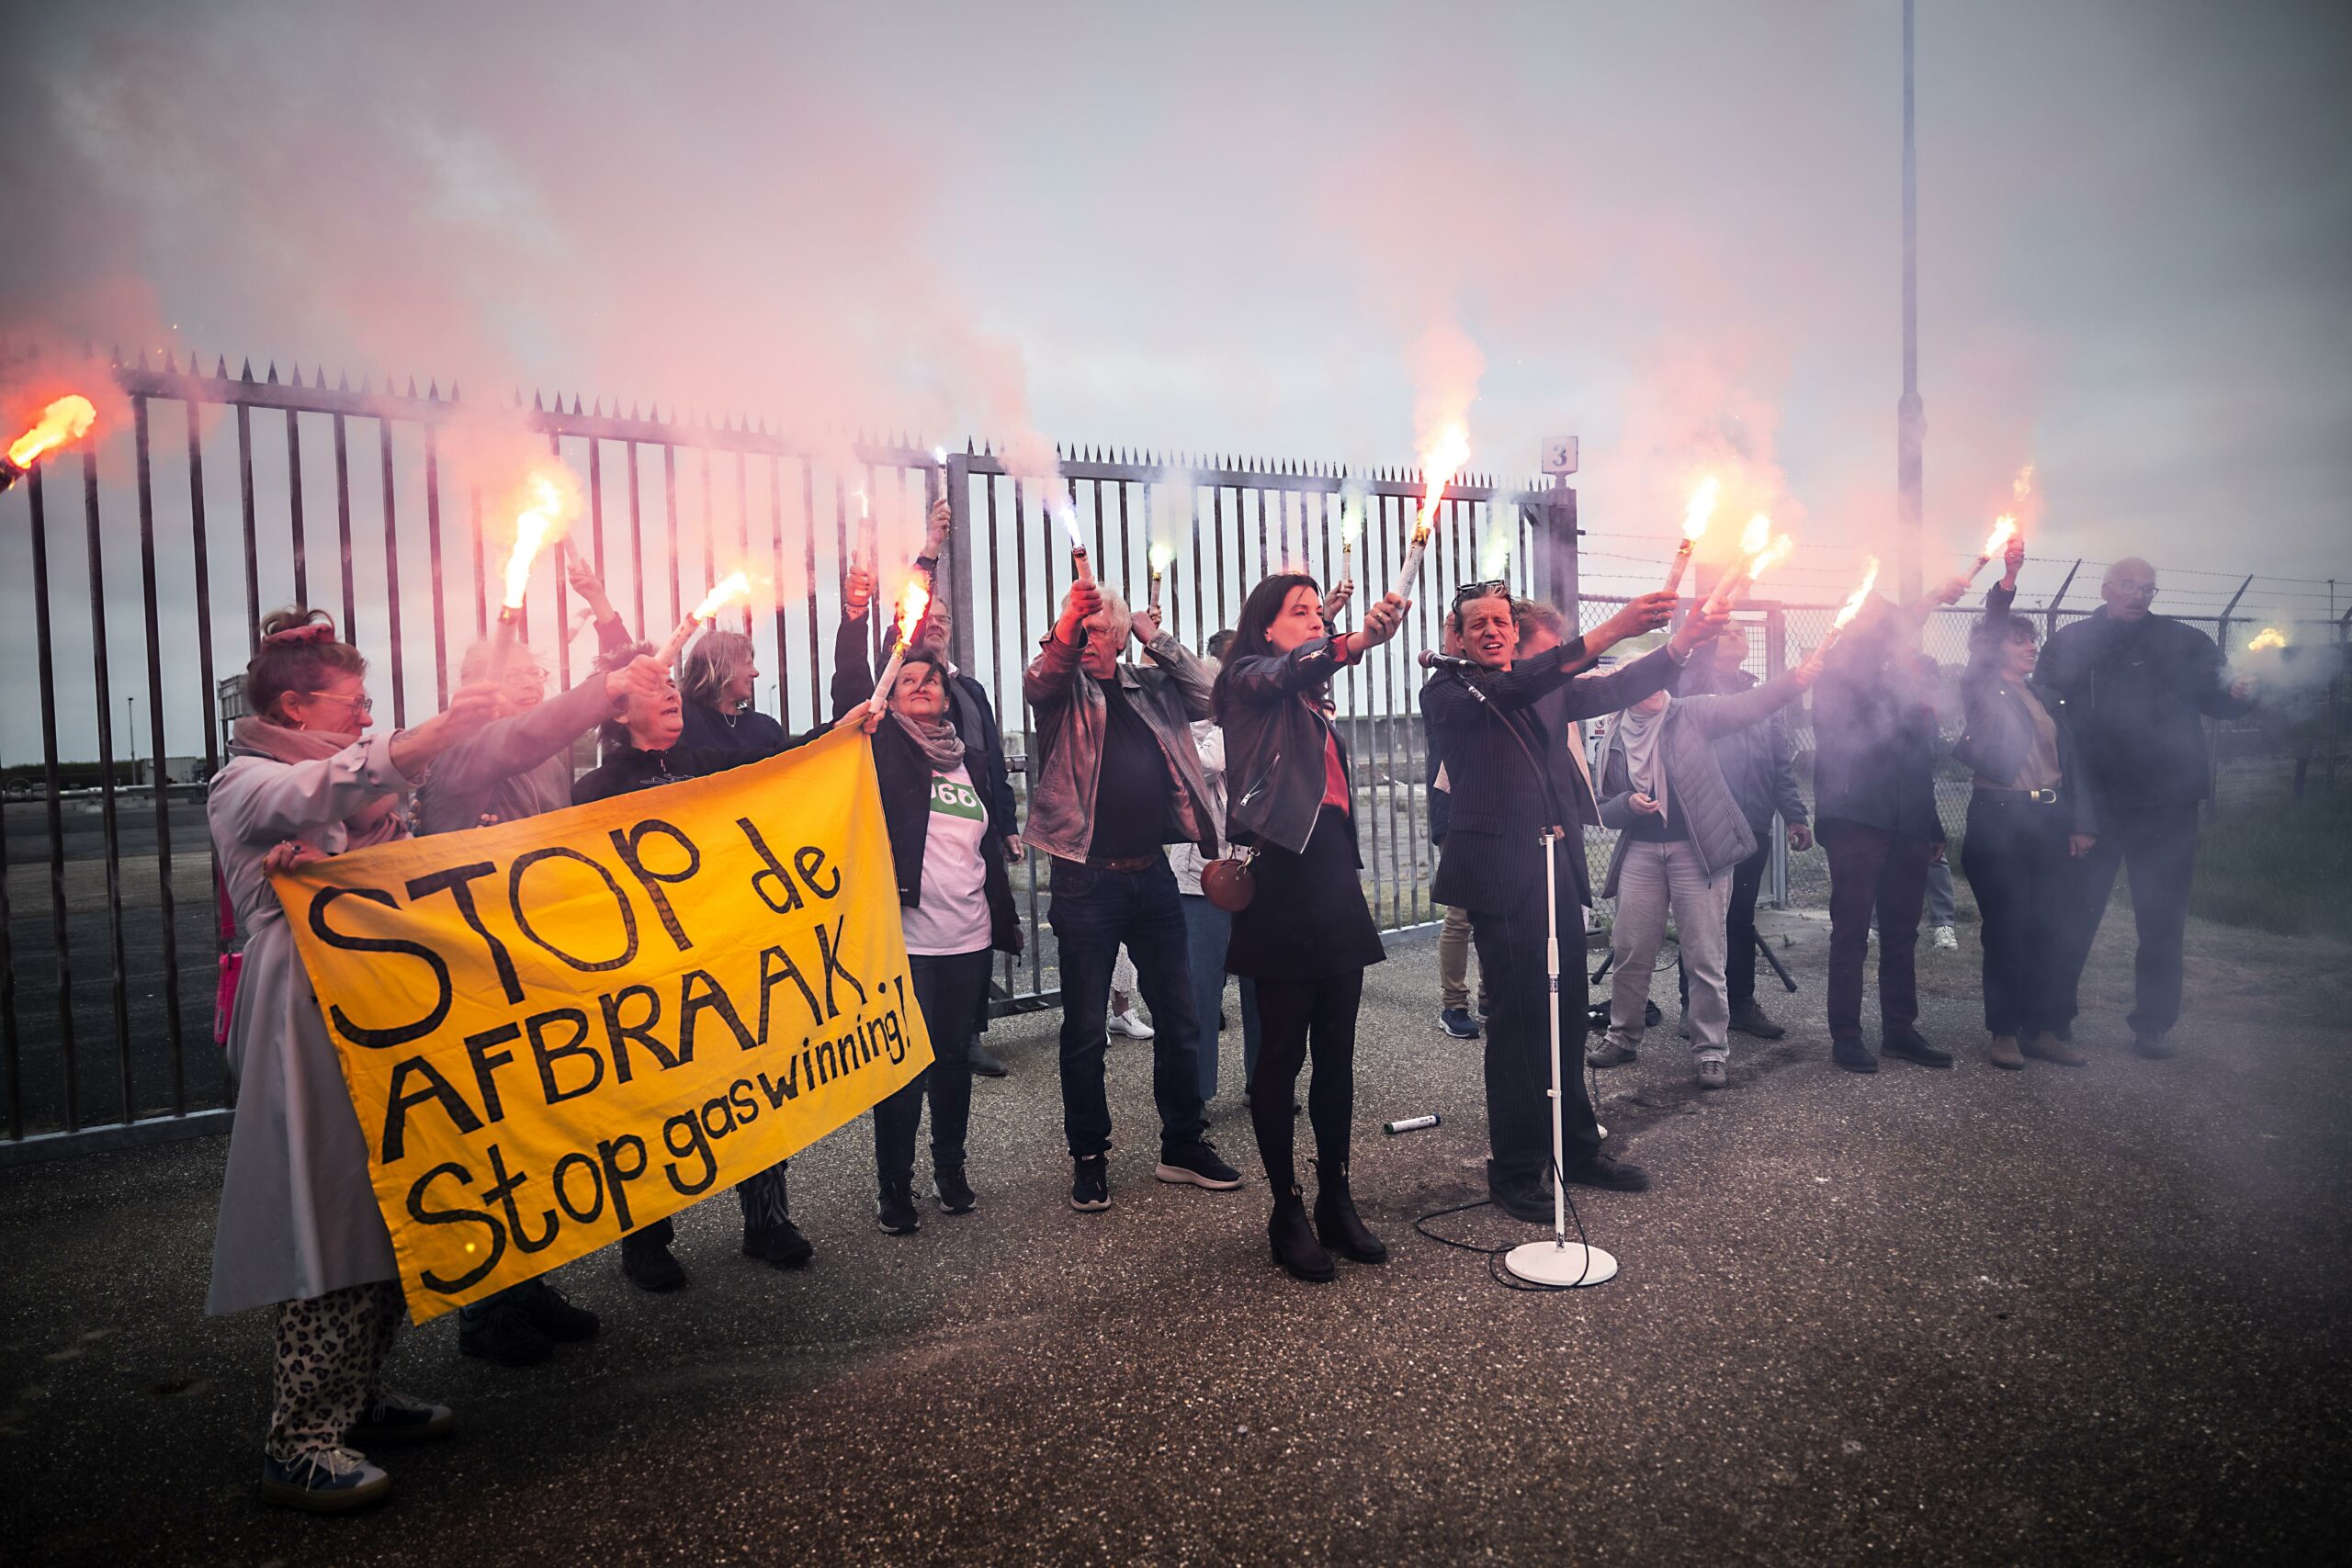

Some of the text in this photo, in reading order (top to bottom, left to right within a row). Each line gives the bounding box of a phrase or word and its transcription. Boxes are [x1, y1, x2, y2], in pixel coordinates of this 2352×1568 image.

[1552, 445, 1567, 467] 3
[931, 783, 977, 807] 66
[308, 817, 841, 1049] STOP de
[406, 1134, 648, 1295] Stop
